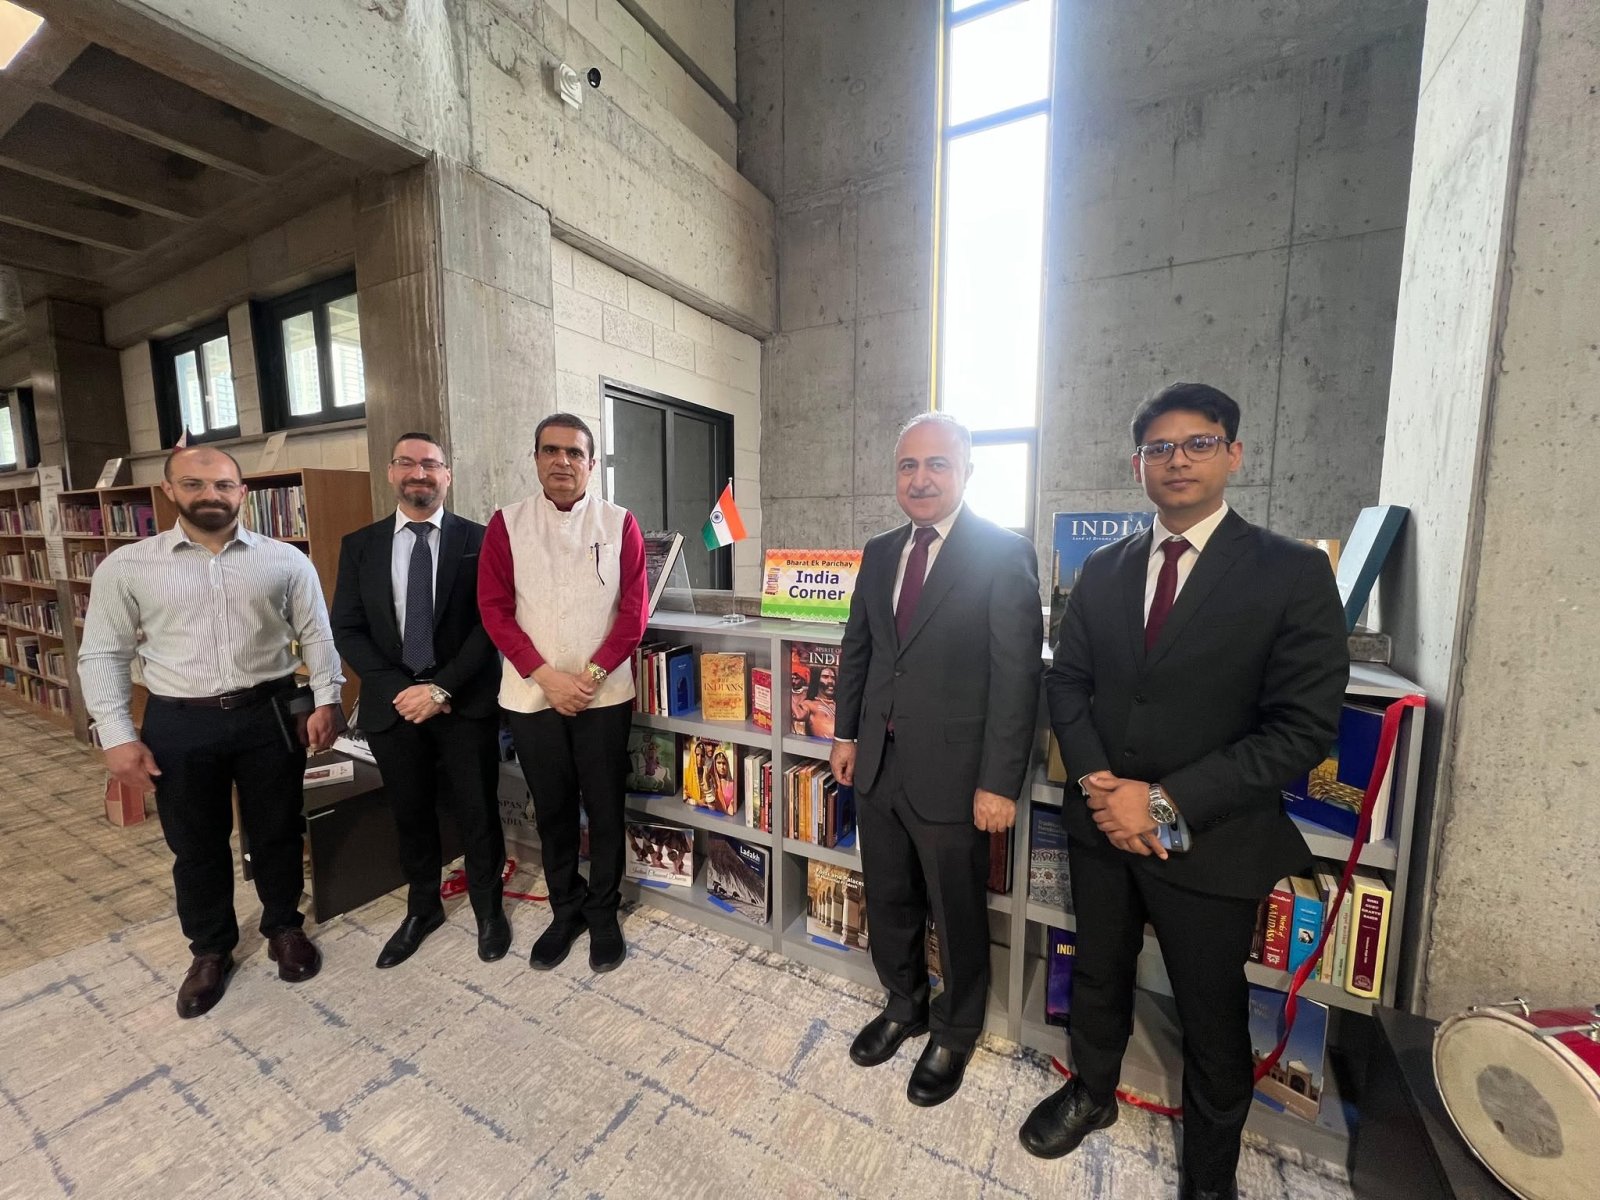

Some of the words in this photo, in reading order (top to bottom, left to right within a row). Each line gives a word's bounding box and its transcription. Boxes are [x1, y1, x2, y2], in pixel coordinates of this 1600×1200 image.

[1072, 520, 1145, 536] INDIA
[821, 560, 853, 568] Parichay
[795, 570, 839, 584] India
[789, 585, 845, 601] Corner
[809, 651, 840, 666] INDI
[704, 683, 743, 691] INDIANS
[740, 846, 761, 861] Ladakh
[1056, 943, 1077, 956] INDI
